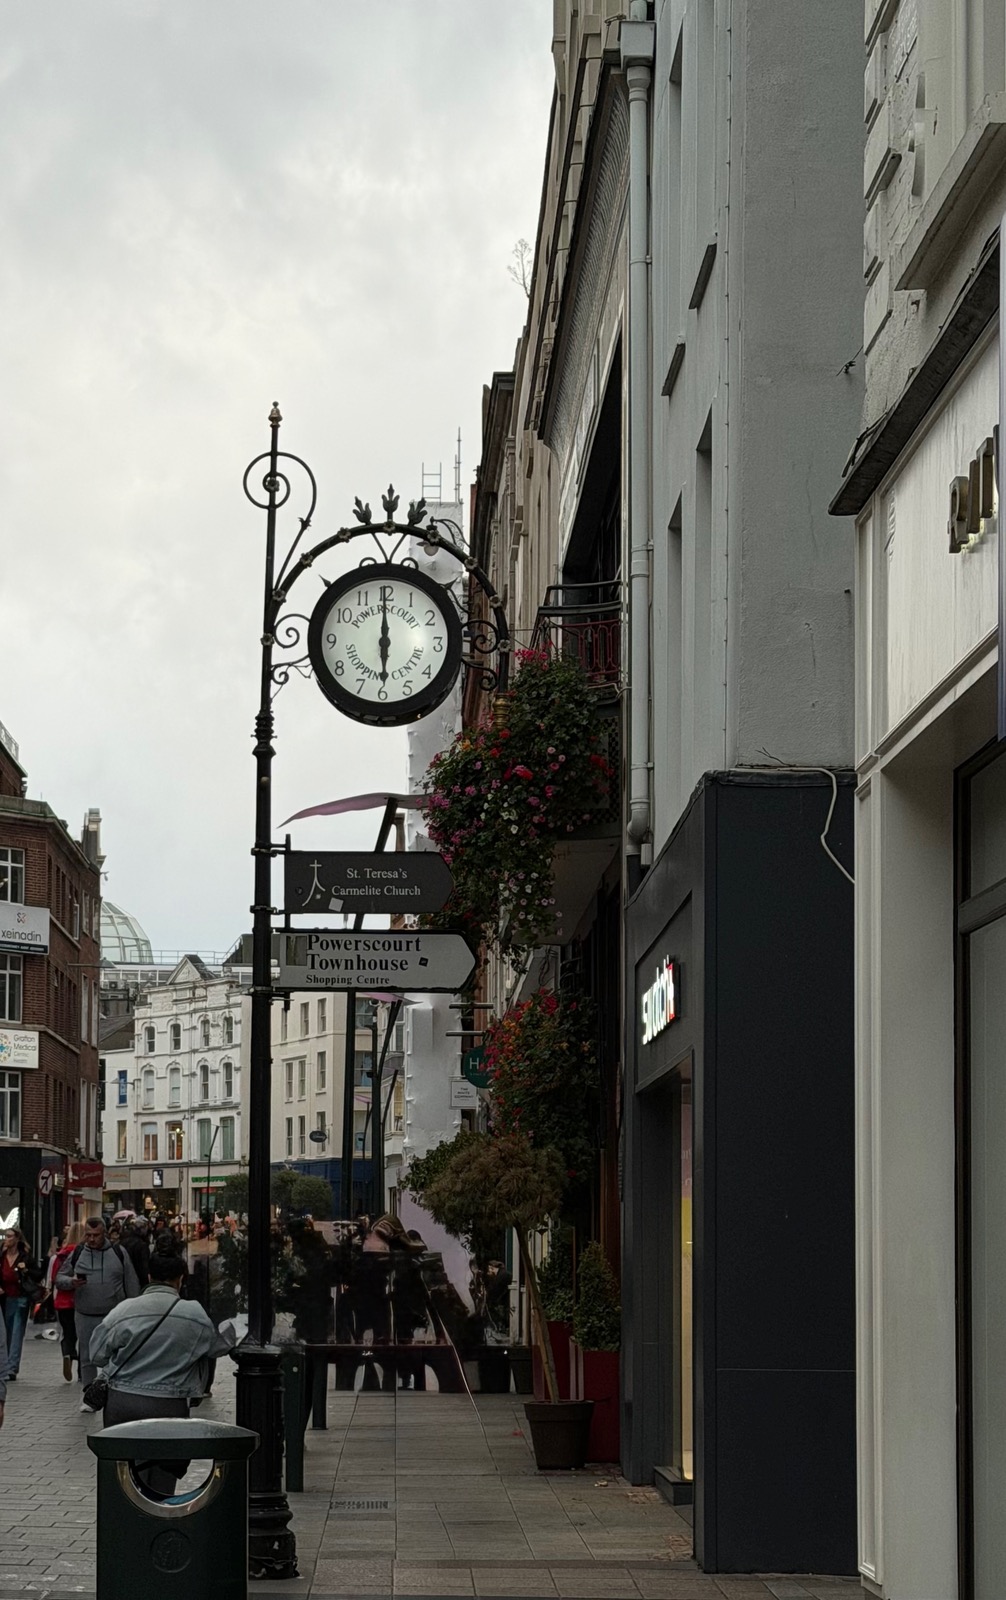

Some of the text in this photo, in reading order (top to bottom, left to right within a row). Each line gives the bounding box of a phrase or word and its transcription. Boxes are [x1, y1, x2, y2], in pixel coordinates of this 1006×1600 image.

[357, 590, 369, 606] 11
[379, 585, 394, 602] 12
[408, 592, 413, 608] 1
[336, 607, 352, 624] 10
[351, 604, 421, 630] POWERSCOURT
[424, 609, 436, 627] 2
[326, 633, 337, 650] 9
[433, 636, 443, 653] 3
[334, 660, 345, 677] 8
[345, 643, 425, 682] SHOPPIN CENTRE
[421, 663, 432, 679] 4
[355, 678, 366, 695] 7
[377, 684, 388, 701] 6
[402, 680, 414, 696] 5
[346, 867, 408, 879] St. Teresa's
[331, 885, 421, 896] Carmelite Church
[1, 928, 42, 942] xeinadin
[306, 934, 422, 952] Powerscourt
[306, 953, 409, 971] Townhouse
[305, 974, 390, 986] Shopping Centre
[469, 1057, 480, 1070] H
